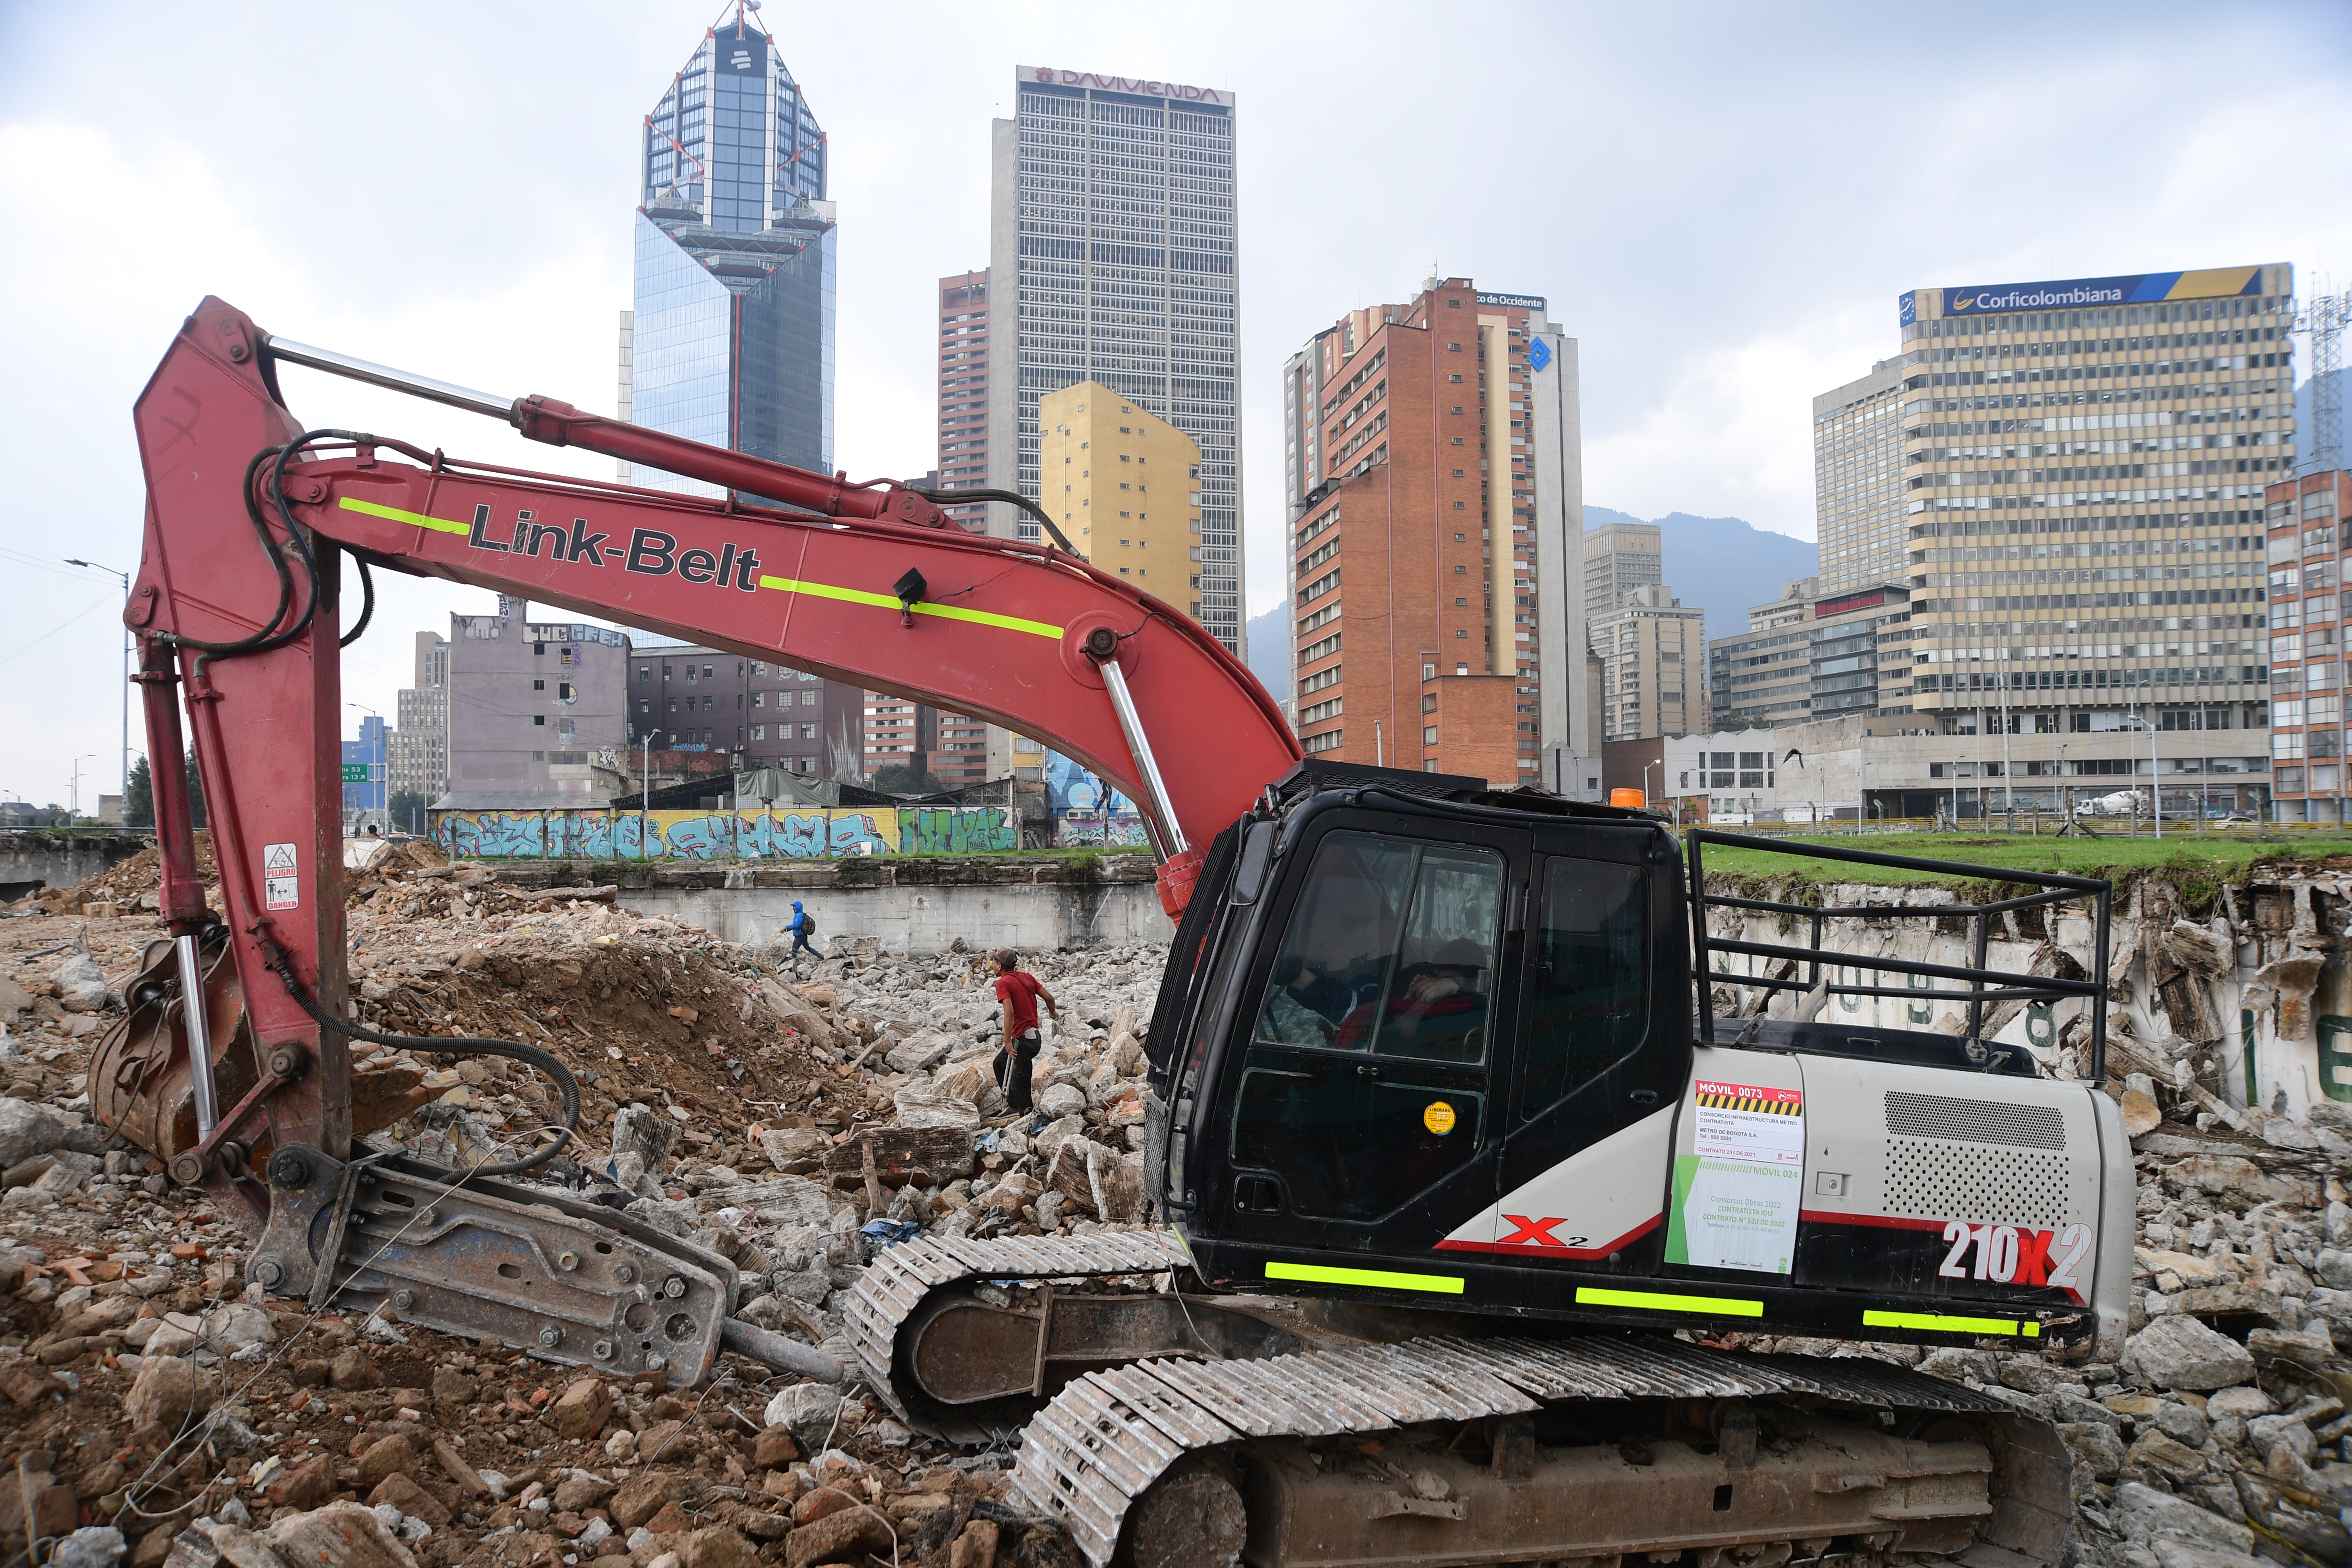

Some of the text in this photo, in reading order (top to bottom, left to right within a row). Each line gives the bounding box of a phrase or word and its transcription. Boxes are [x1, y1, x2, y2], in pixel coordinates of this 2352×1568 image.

[1062, 70, 1219, 102] DAVIVIENDA
[1487, 294, 1498, 303] de
[1500, 296, 1542, 308] Occidente
[1976, 286, 2122, 309] Corficolombiana
[468, 504, 760, 592] Link-Belt
[267, 868, 296, 877] PELIGRO
[1699, 1083, 1763, 1098] MÓVIL 0073
[1731, 1115, 1779, 1124] INFRAESTRUCTURA
[1753, 1166, 1798, 1179] MÓVIL 024
[1711, 1195, 1743, 1204] Consorcio
[1745, 1198, 1763, 1207] Obras
[1718, 1205, 1759, 1215] CONTRATISTA
[1703, 1214, 1737, 1222] CONTRATO
[1938, 1220, 2093, 1288] 210X2
